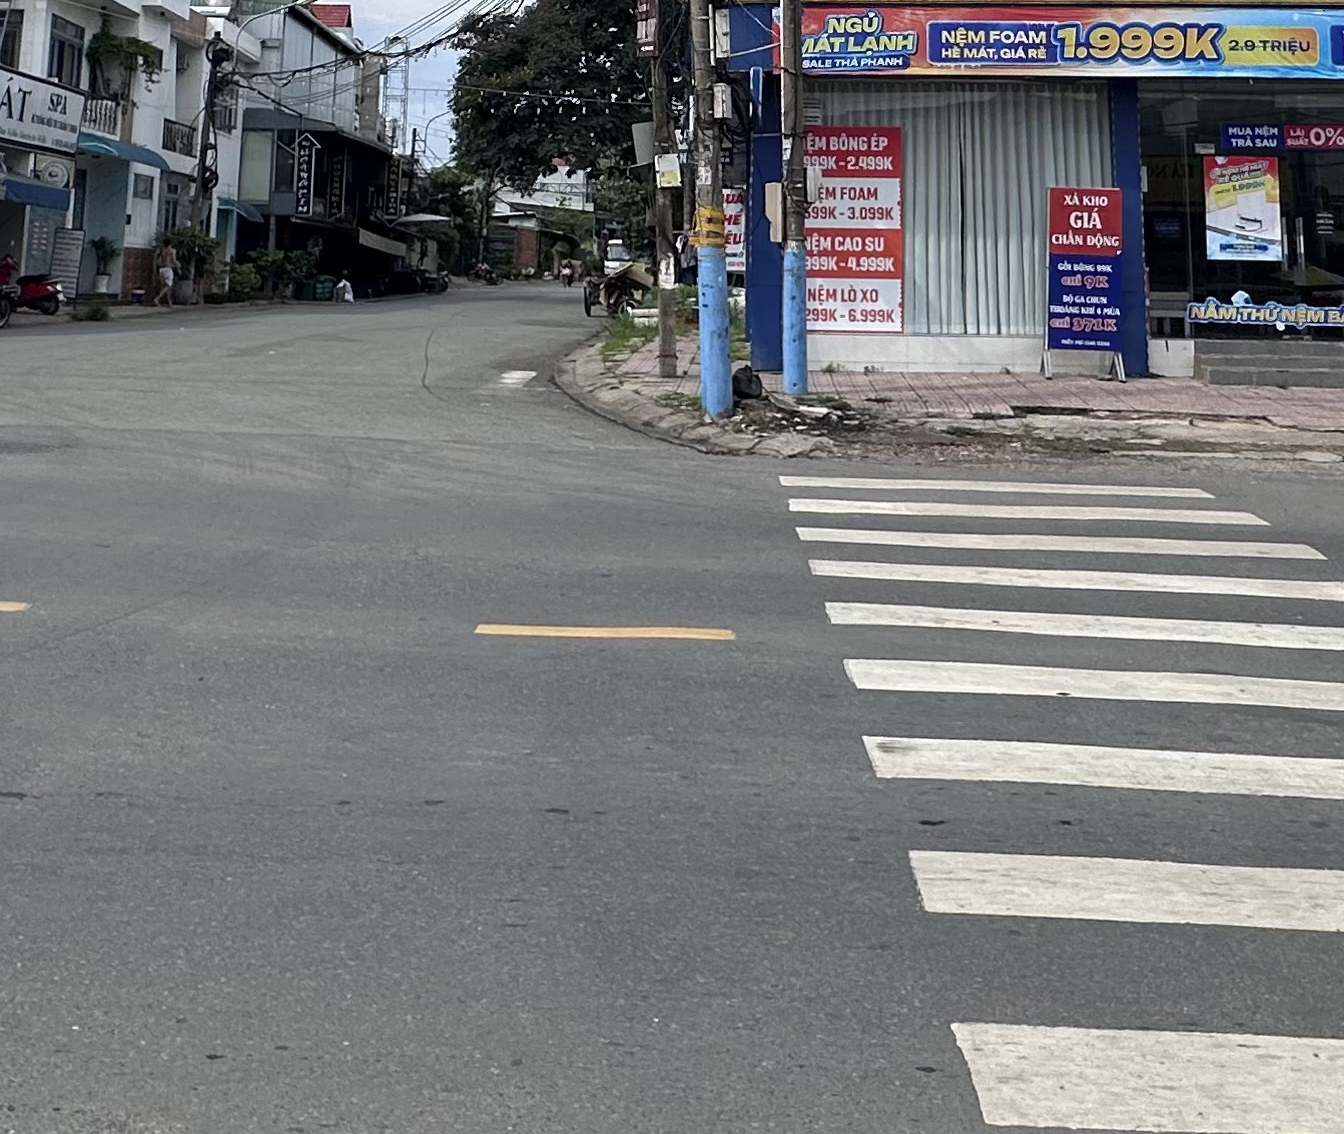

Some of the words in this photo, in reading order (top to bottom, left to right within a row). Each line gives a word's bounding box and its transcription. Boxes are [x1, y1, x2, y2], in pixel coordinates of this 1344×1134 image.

[827, 11, 879, 34] NGỦ
[941, 27, 985, 46] NỆM
[989, 29, 1047, 44] FOAM
[1057, 25, 1218, 60] 1.999K
[848, 35, 914, 56] LẠNH
[941, 46, 960, 59] HÈ
[963, 46, 999, 60] MÁT,
[1002, 46, 1027, 59] GIÁ
[1028, 45, 1047, 59] RẺ
[1258, 37, 1311, 56] TRIỆU
[802, 60, 832, 69] SALE
[834, 56, 858, 67] THẢ
[860, 56, 903, 67] PHANH
[48, 93, 68, 115] SPA
[1228, 127, 1253, 136] MUA
[1255, 126, 1279, 137] NỆM
[803, 133, 826, 154] ỆM
[829, 132, 868, 151] BÔNG
[871, 132, 889, 151] ÉP
[1230, 135, 1254, 147] TRẢ
[1255, 138, 1277, 147] SAU
[846, 155, 893, 170] 2.499K
[840, 186, 878, 201] FOAM
[1063, 191, 1080, 206] XẢ
[1082, 195, 1109, 207] KHO
[847, 206, 894, 221] 3.099K
[1069, 207, 1103, 229] GIÁ
[834, 236, 862, 252] CAO
[865, 236, 884, 252] SU
[1051, 230, 1084, 246] CHẤN
[1086, 232, 1120, 249] ĐỘNG
[847, 256, 895, 272] 4.999K
[1083, 275, 1109, 290] 9K
[807, 284, 837, 306] NỆM
[860, 288, 879, 303] XO
[1074, 295, 1085, 304] GA
[848, 308, 895, 323] 6.999K
[1281, 306, 1324, 327] NỆM
